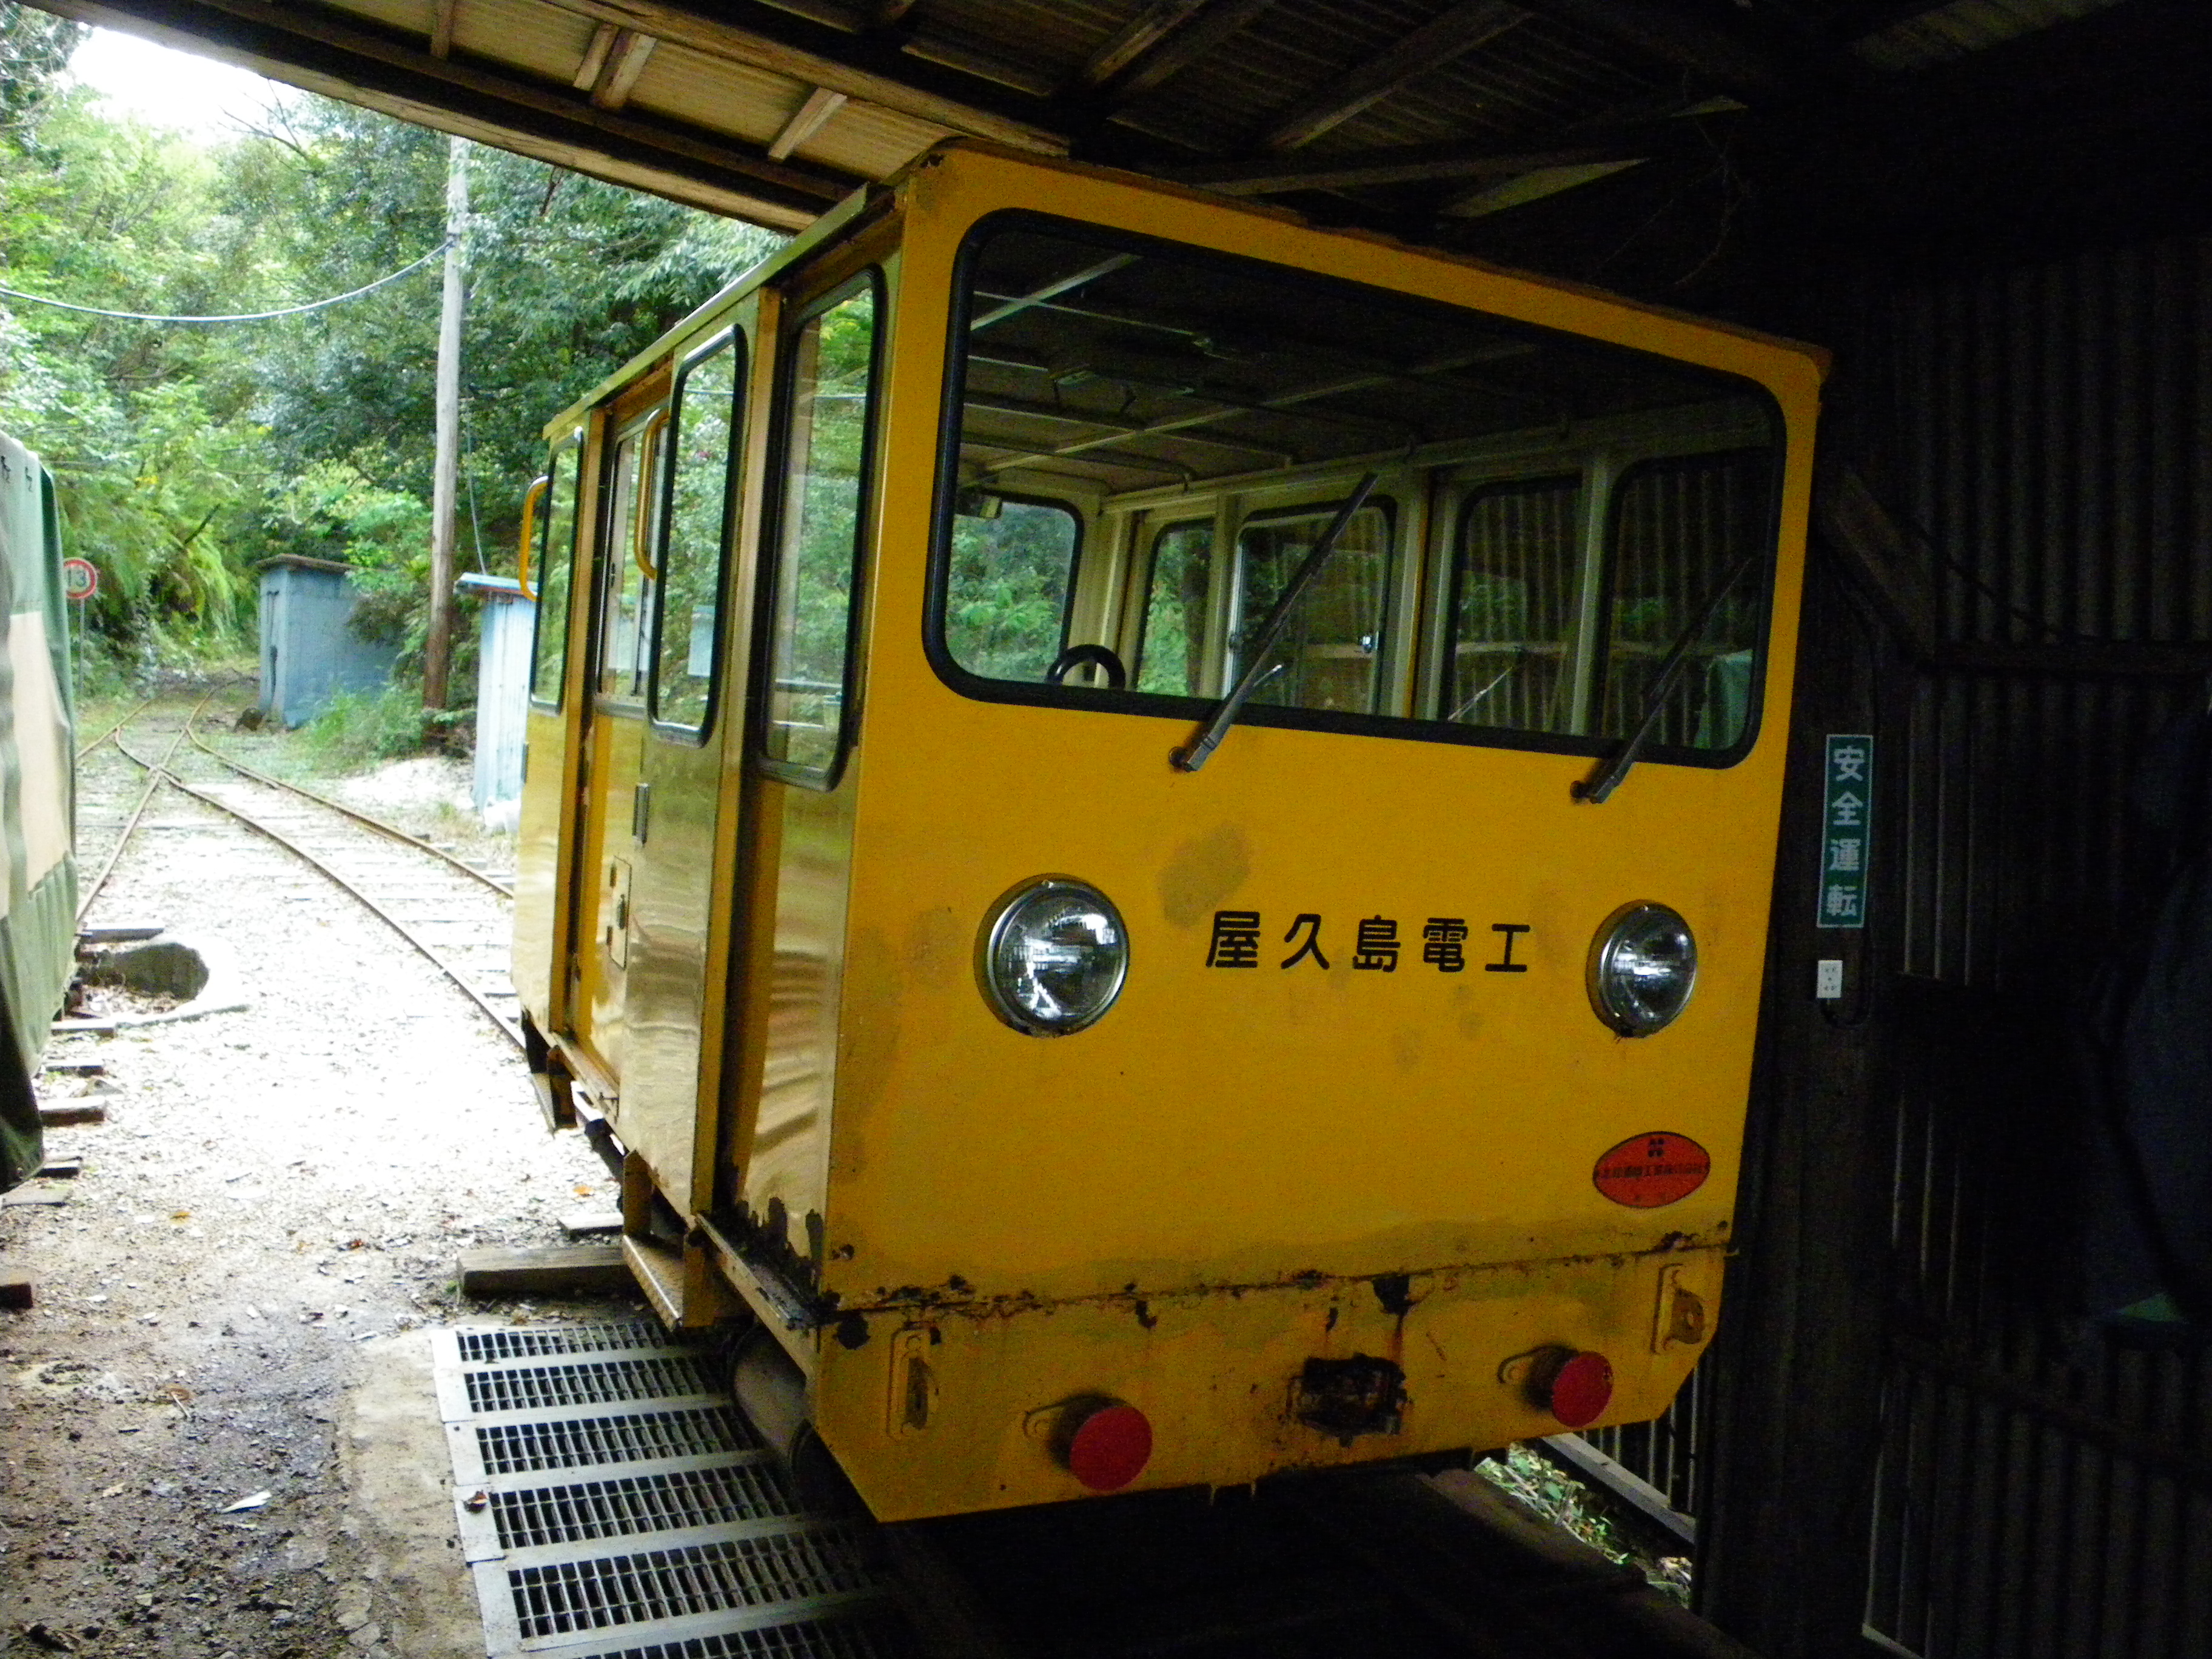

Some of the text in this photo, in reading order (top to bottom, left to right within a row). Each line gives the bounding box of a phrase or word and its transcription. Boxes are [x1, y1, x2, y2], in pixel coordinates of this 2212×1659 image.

[67, 569, 87, 587] 13
[1826, 745, 1865, 917] 安全運転
[1205, 910, 1530, 973] 屋久島電工
